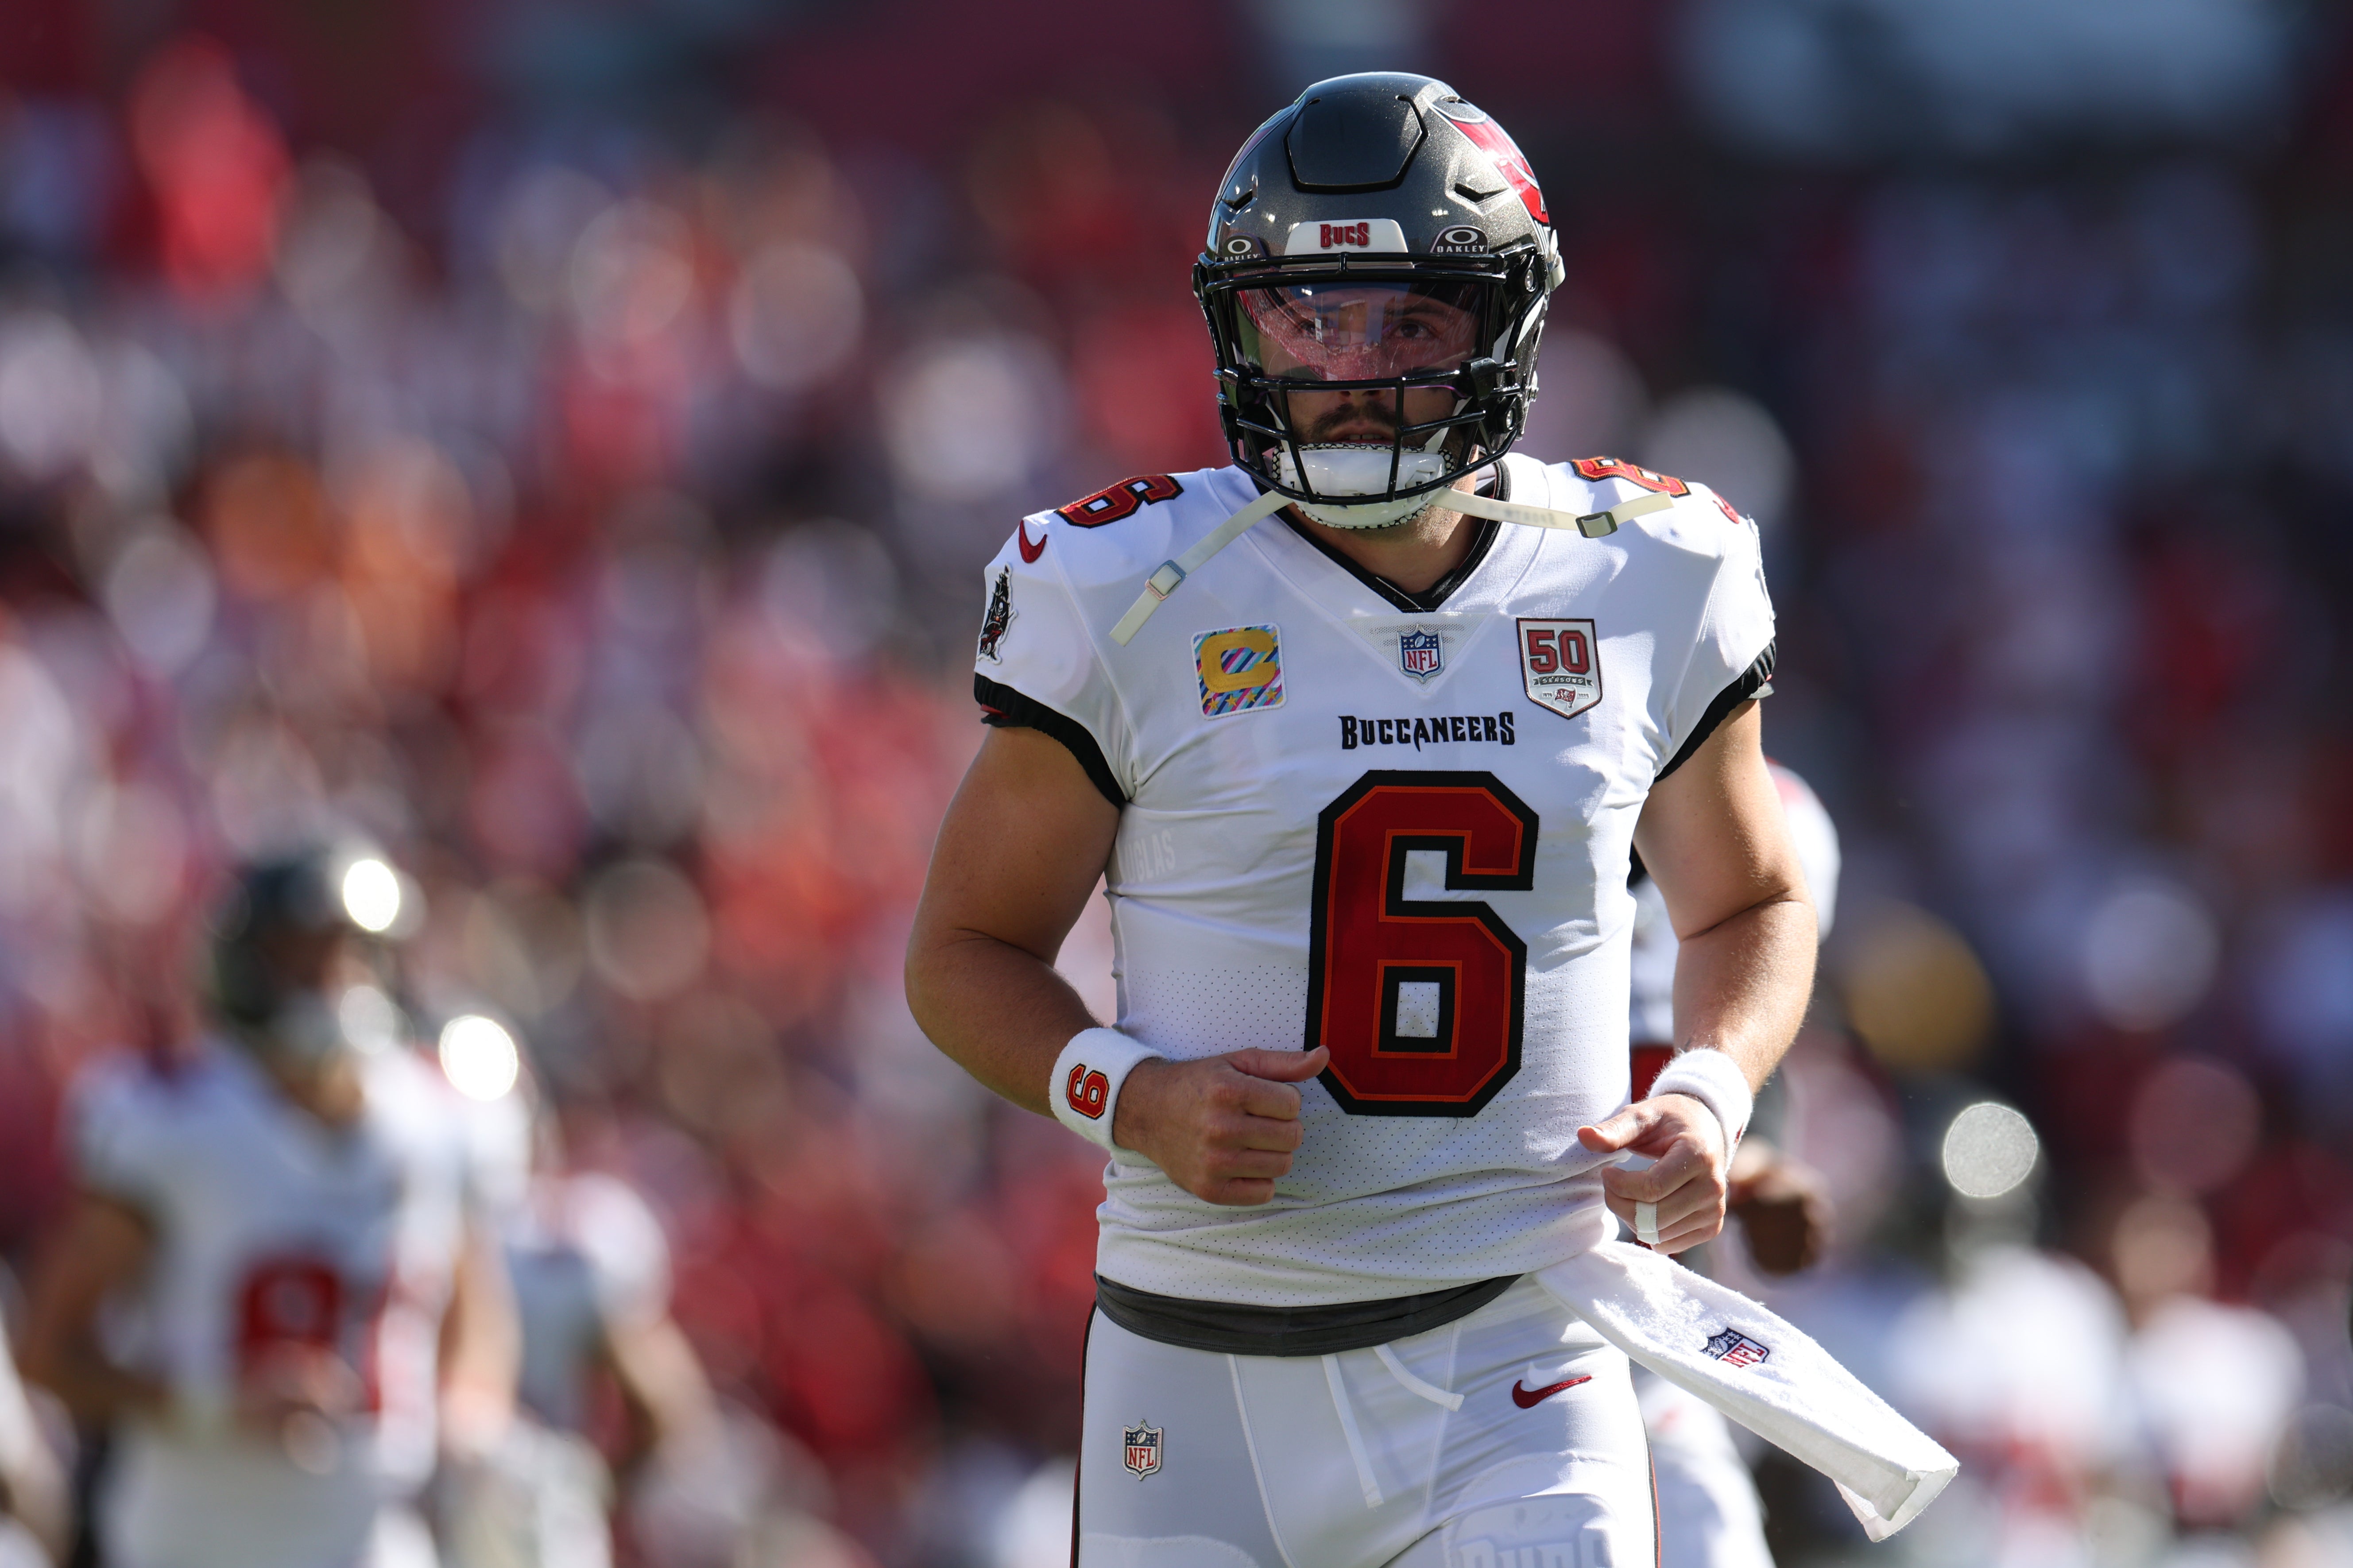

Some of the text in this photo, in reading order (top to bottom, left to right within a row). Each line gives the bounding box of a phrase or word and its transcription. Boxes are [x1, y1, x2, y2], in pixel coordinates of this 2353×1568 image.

[1320, 222, 1369, 248] BUCS
[1225, 254, 1258, 262] OAKLEY
[1053, 475, 1184, 529] 6
[1200, 629, 1277, 693] C
[1406, 650, 1437, 672] NFL
[1526, 629, 1591, 675] 50
[1338, 712, 1515, 752] BUCCANEERS
[1304, 770, 1539, 1118] 6
[1722, 1343, 1765, 1368] NFL
[1128, 1447, 1154, 1469] NFL
